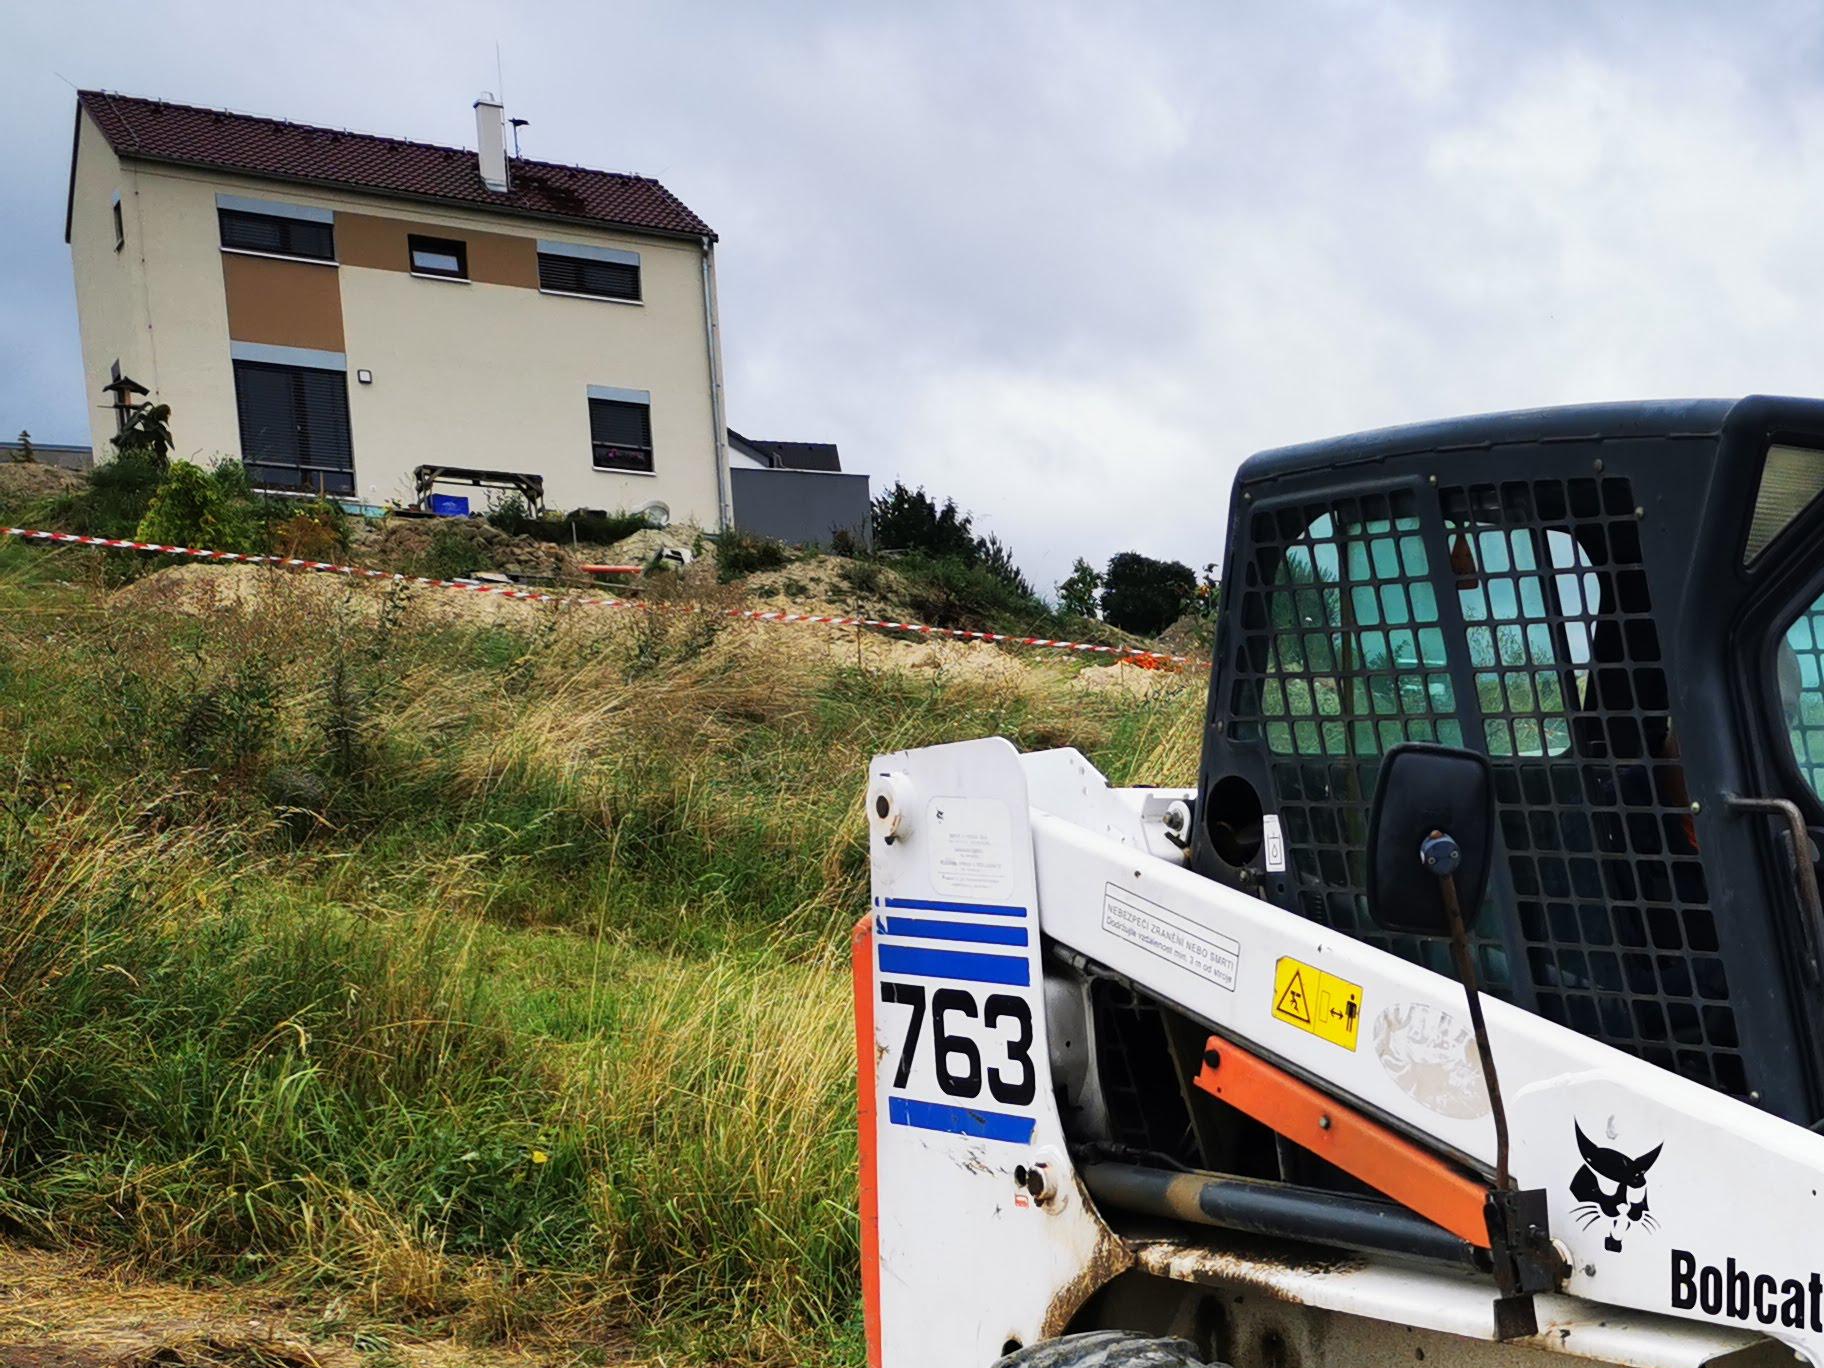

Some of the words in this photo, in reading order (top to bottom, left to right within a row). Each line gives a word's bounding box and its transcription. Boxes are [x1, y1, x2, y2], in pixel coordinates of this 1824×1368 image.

[1186, 941, 1208, 958] NEBO
[1210, 952, 1234, 972] SMRTI
[880, 981, 1036, 1106] 763
[1671, 1248, 1823, 1333] Bobcat
